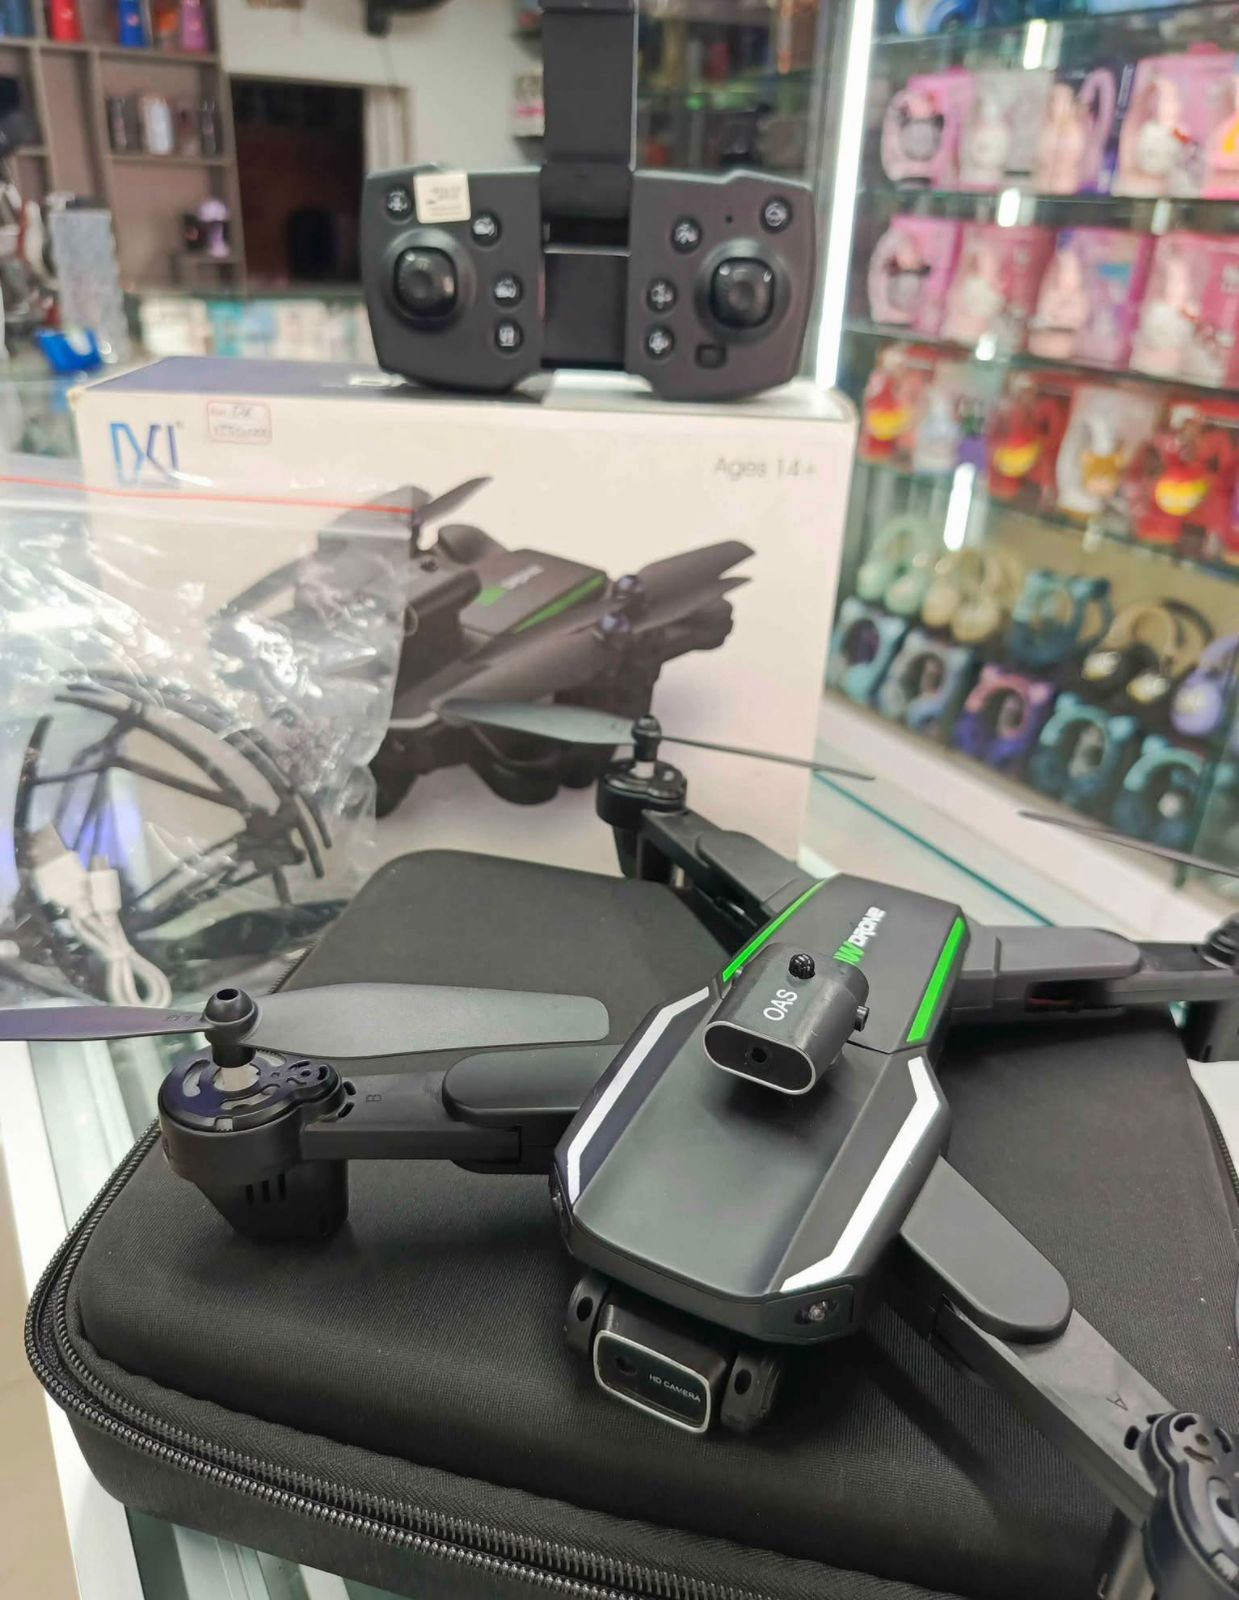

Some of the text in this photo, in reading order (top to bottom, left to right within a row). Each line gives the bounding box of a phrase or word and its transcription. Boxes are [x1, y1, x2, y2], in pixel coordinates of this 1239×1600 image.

[713, 456, 817, 482] Ages 14+
[763, 989, 798, 1021] OAS
[649, 1373, 701, 1403] HD CAMERA
[1106, 1393, 1129, 1412] A
